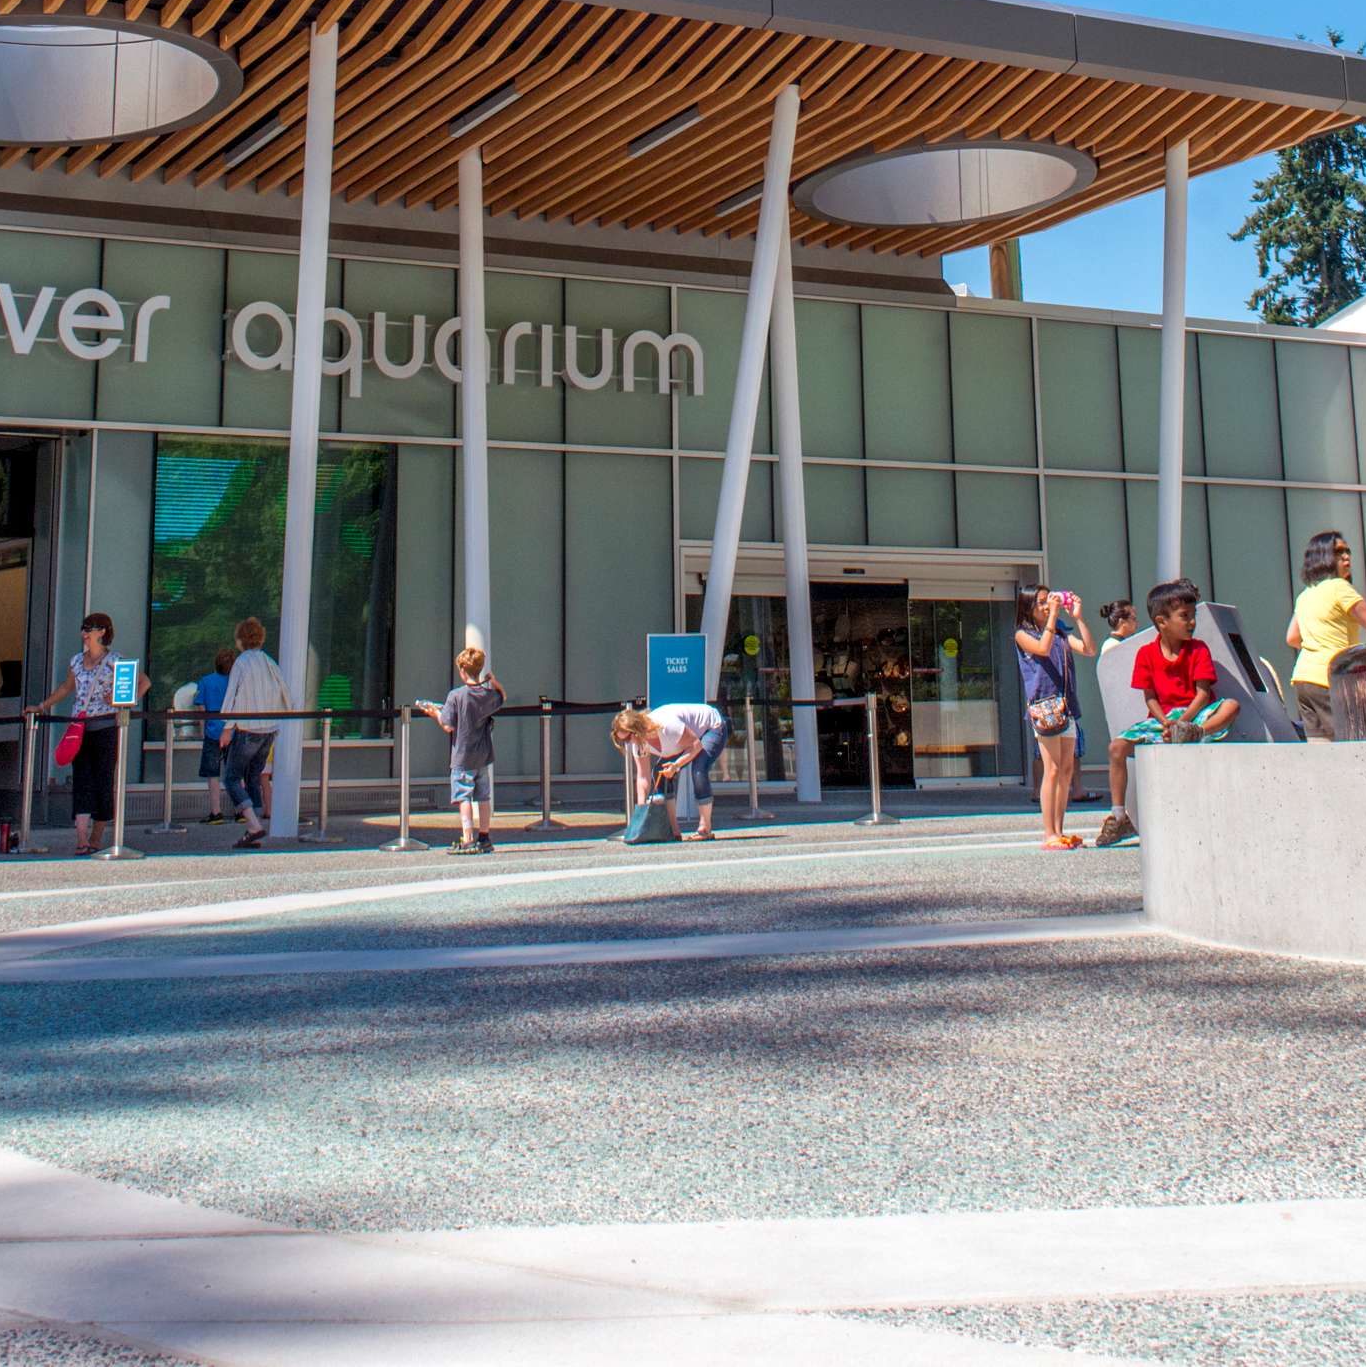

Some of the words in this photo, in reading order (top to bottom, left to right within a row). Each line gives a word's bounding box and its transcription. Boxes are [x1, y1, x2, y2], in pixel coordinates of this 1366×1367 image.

[232, 301, 704, 398] aquarium
[665, 657, 688, 665] TICKET
[667, 665, 687, 673] SALES
